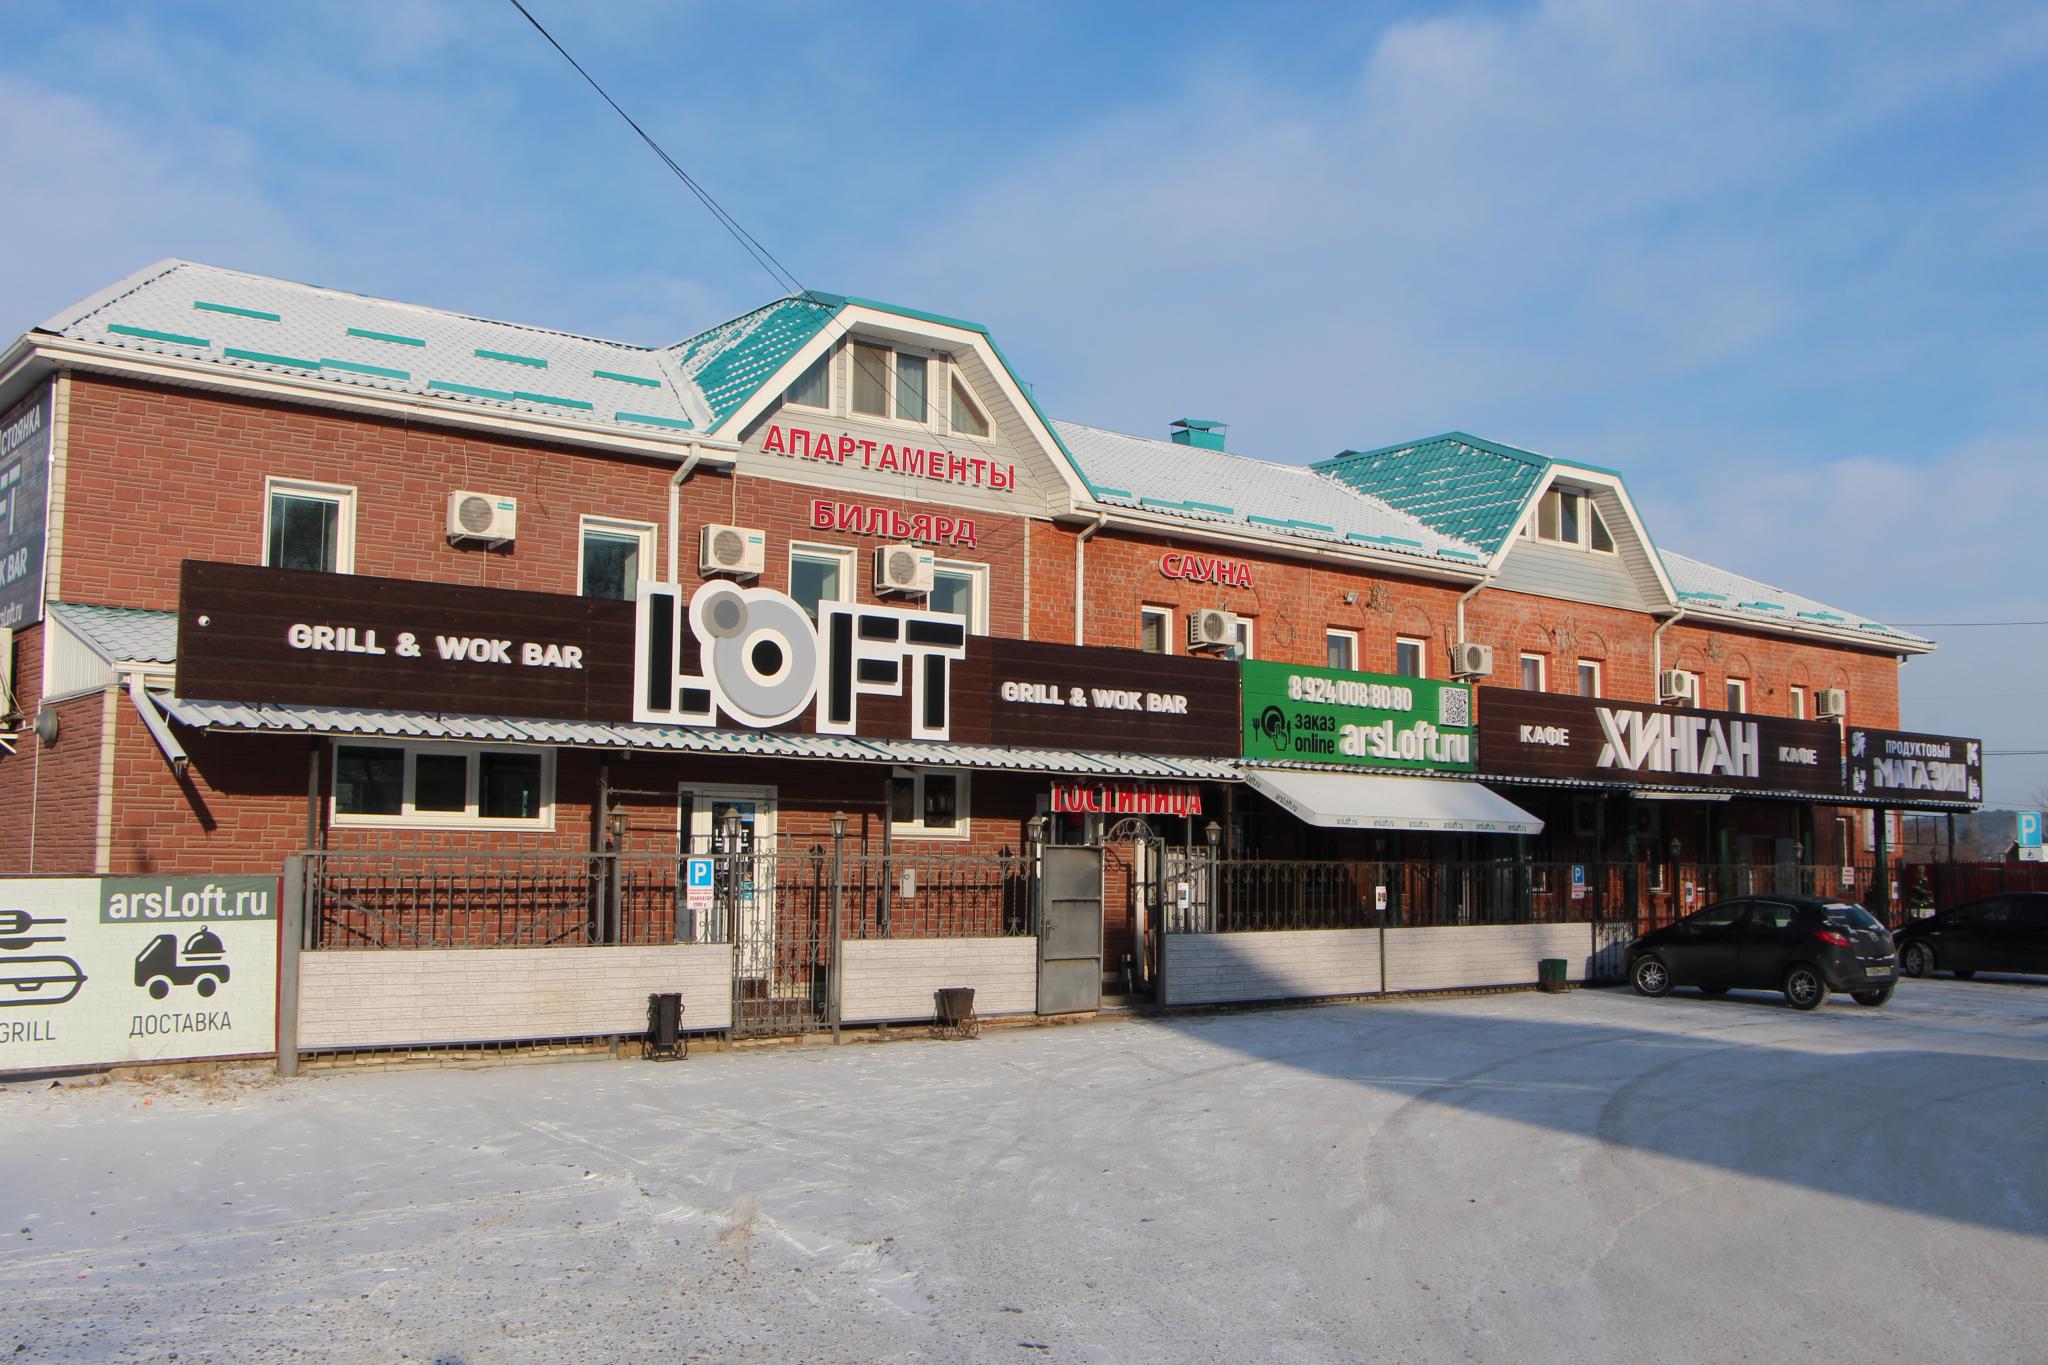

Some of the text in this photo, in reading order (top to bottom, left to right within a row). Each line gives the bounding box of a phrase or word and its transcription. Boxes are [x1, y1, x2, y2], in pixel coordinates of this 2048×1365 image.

[0, 404, 40, 456] СТОЯНКА
[762, 425, 1016, 492] АПАРТАМЕНТЫ
[810, 499, 978, 549] БИЛЬЯРД
[7, 547, 27, 583] BAR
[1159, 553, 1253, 588] САУНА
[288, 623, 583, 669] GRILL & WOK BAR
[633, 580, 966, 741] LOFT
[1001, 681, 1187, 714] GRILL & WOK BAR
[1295, 734, 1335, 755] online
[1339, 720, 1470, 763] arsLoft.ru
[1520, 725, 1570, 747] КАФЕ
[1595, 707, 1759, 778] ХИНГАН
[1885, 740, 1951, 759] ПРОДУКТОВЫЙ
[1779, 746, 1818, 765] КАФЕ
[1873, 757, 1967, 792] МАГАЗИН
[1050, 781, 1202, 818] ГОСТИНИЦА
[109, 884, 268, 919] arsLoft.ru
[0, 1021, 56, 1043] GRILL
[129, 1012, 232, 1039] ДОСТАВКА
